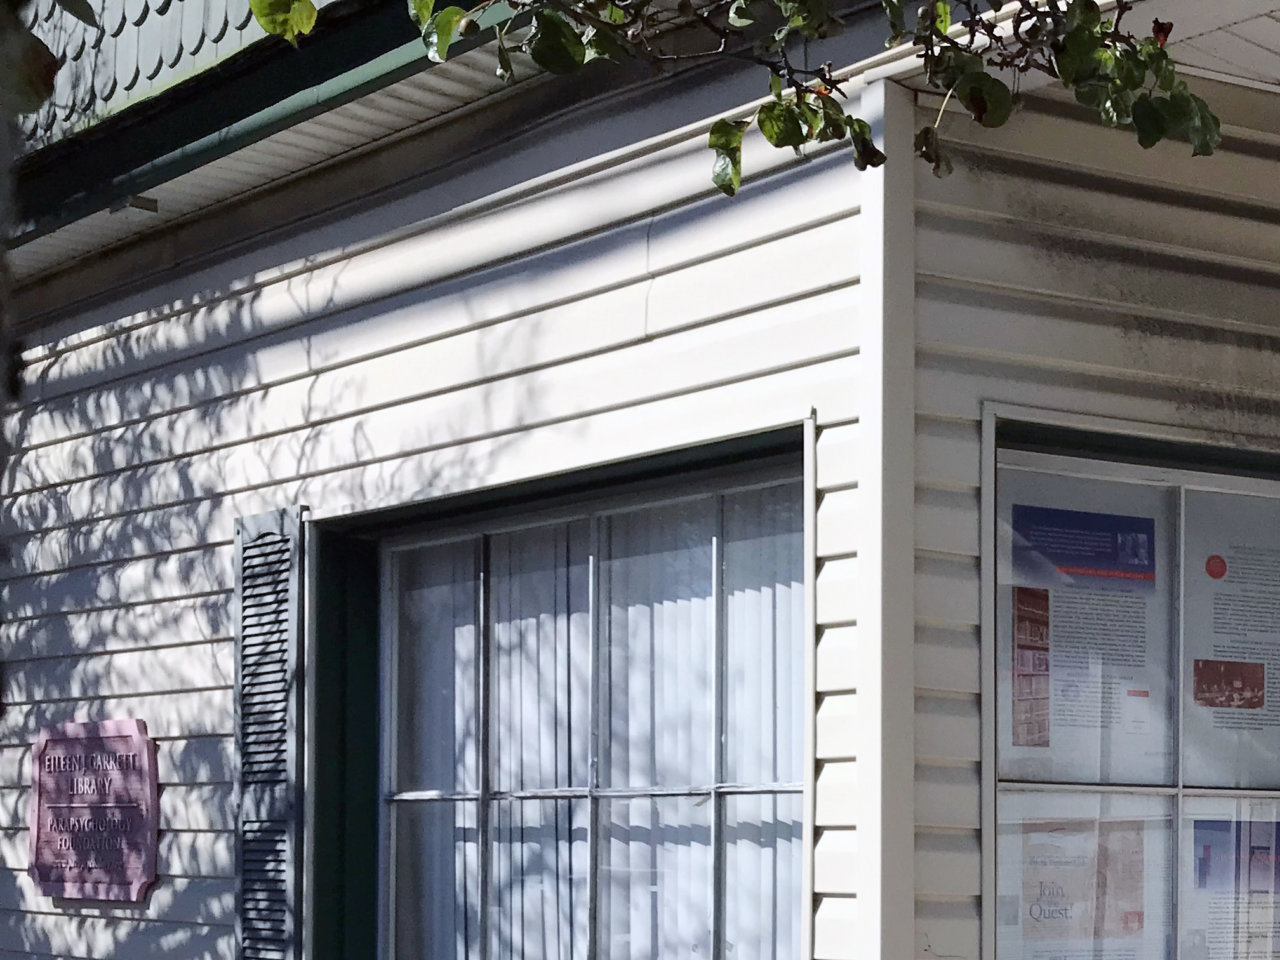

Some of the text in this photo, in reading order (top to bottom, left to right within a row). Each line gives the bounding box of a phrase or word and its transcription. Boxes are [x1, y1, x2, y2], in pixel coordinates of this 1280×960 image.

[45, 755, 80, 773] EILEEN
[69, 777, 112, 794] LIBRARY
[1037, 880, 1065, 902] Join
[1029, 903, 1073, 922] Quest!
